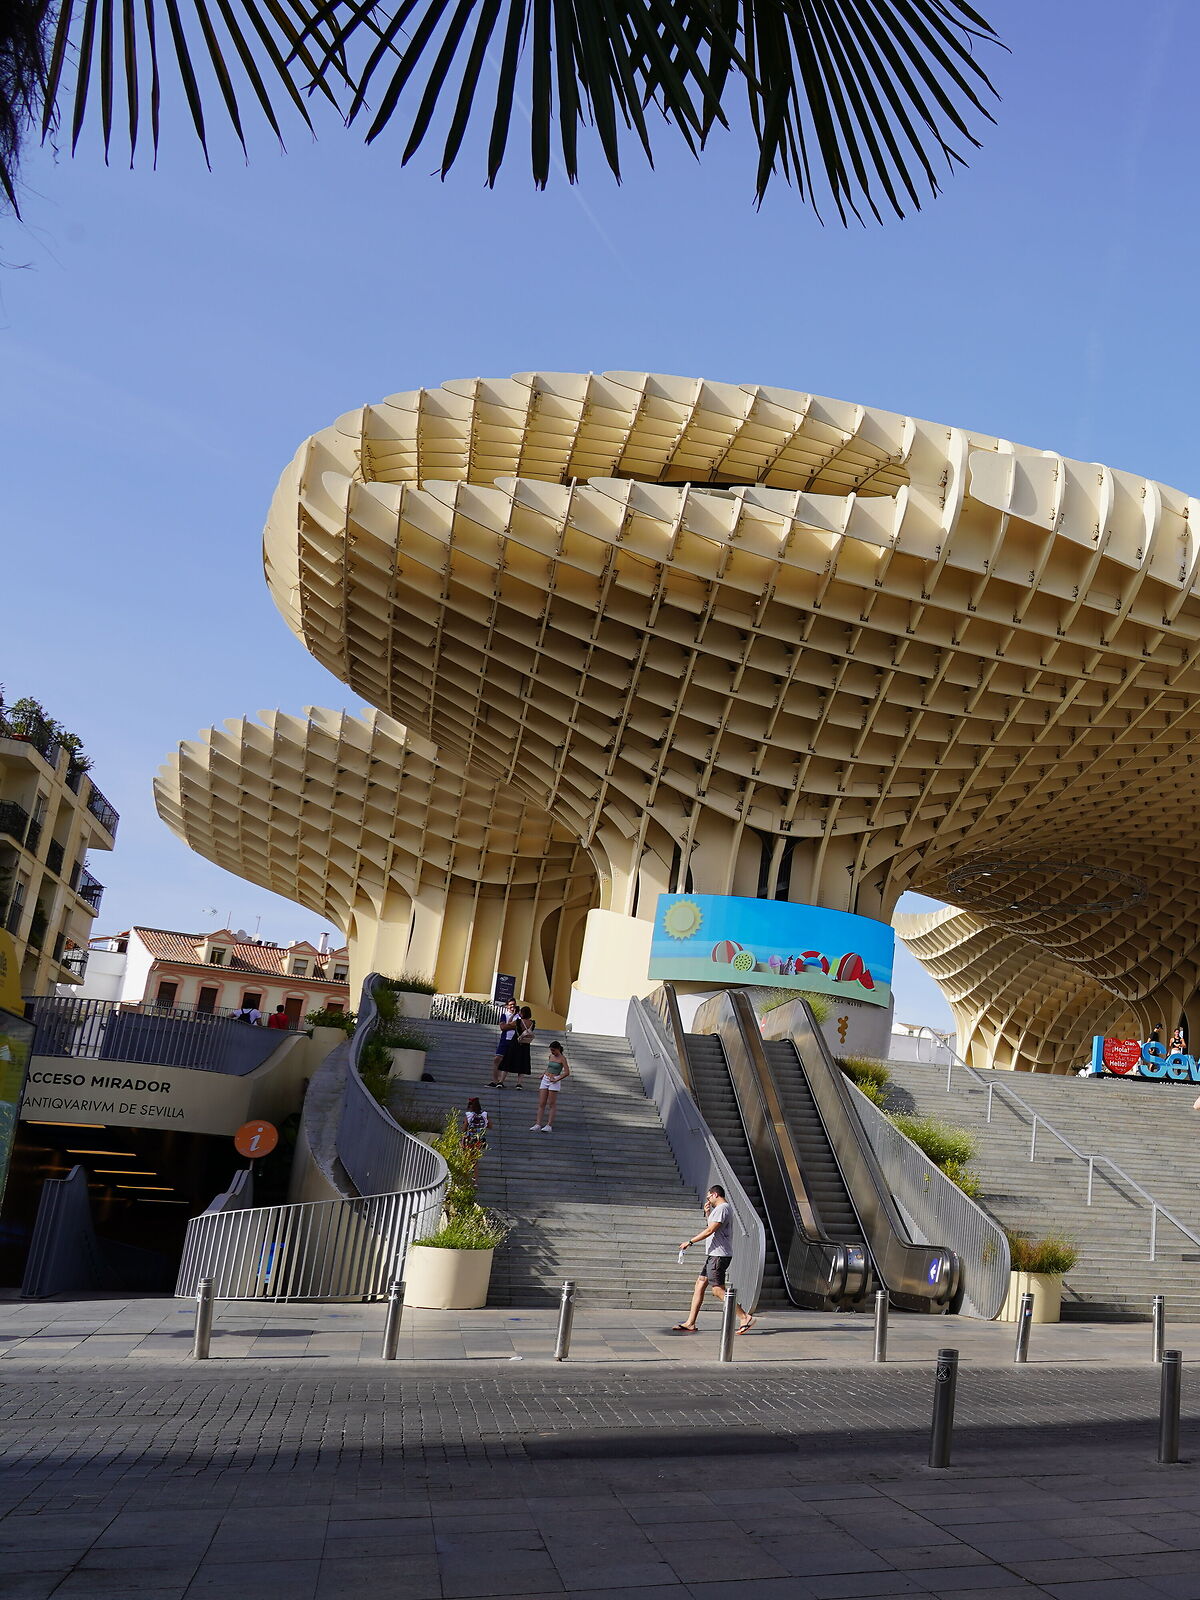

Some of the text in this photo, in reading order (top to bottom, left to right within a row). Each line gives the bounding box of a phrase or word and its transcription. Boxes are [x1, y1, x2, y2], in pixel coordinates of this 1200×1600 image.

[1092, 1035, 1104, 1073] I
[26, 1072, 171, 1093] ACCESO MIRADOR
[22, 1096, 185, 1118] ANTIQVARIVM DE SEVILLA
